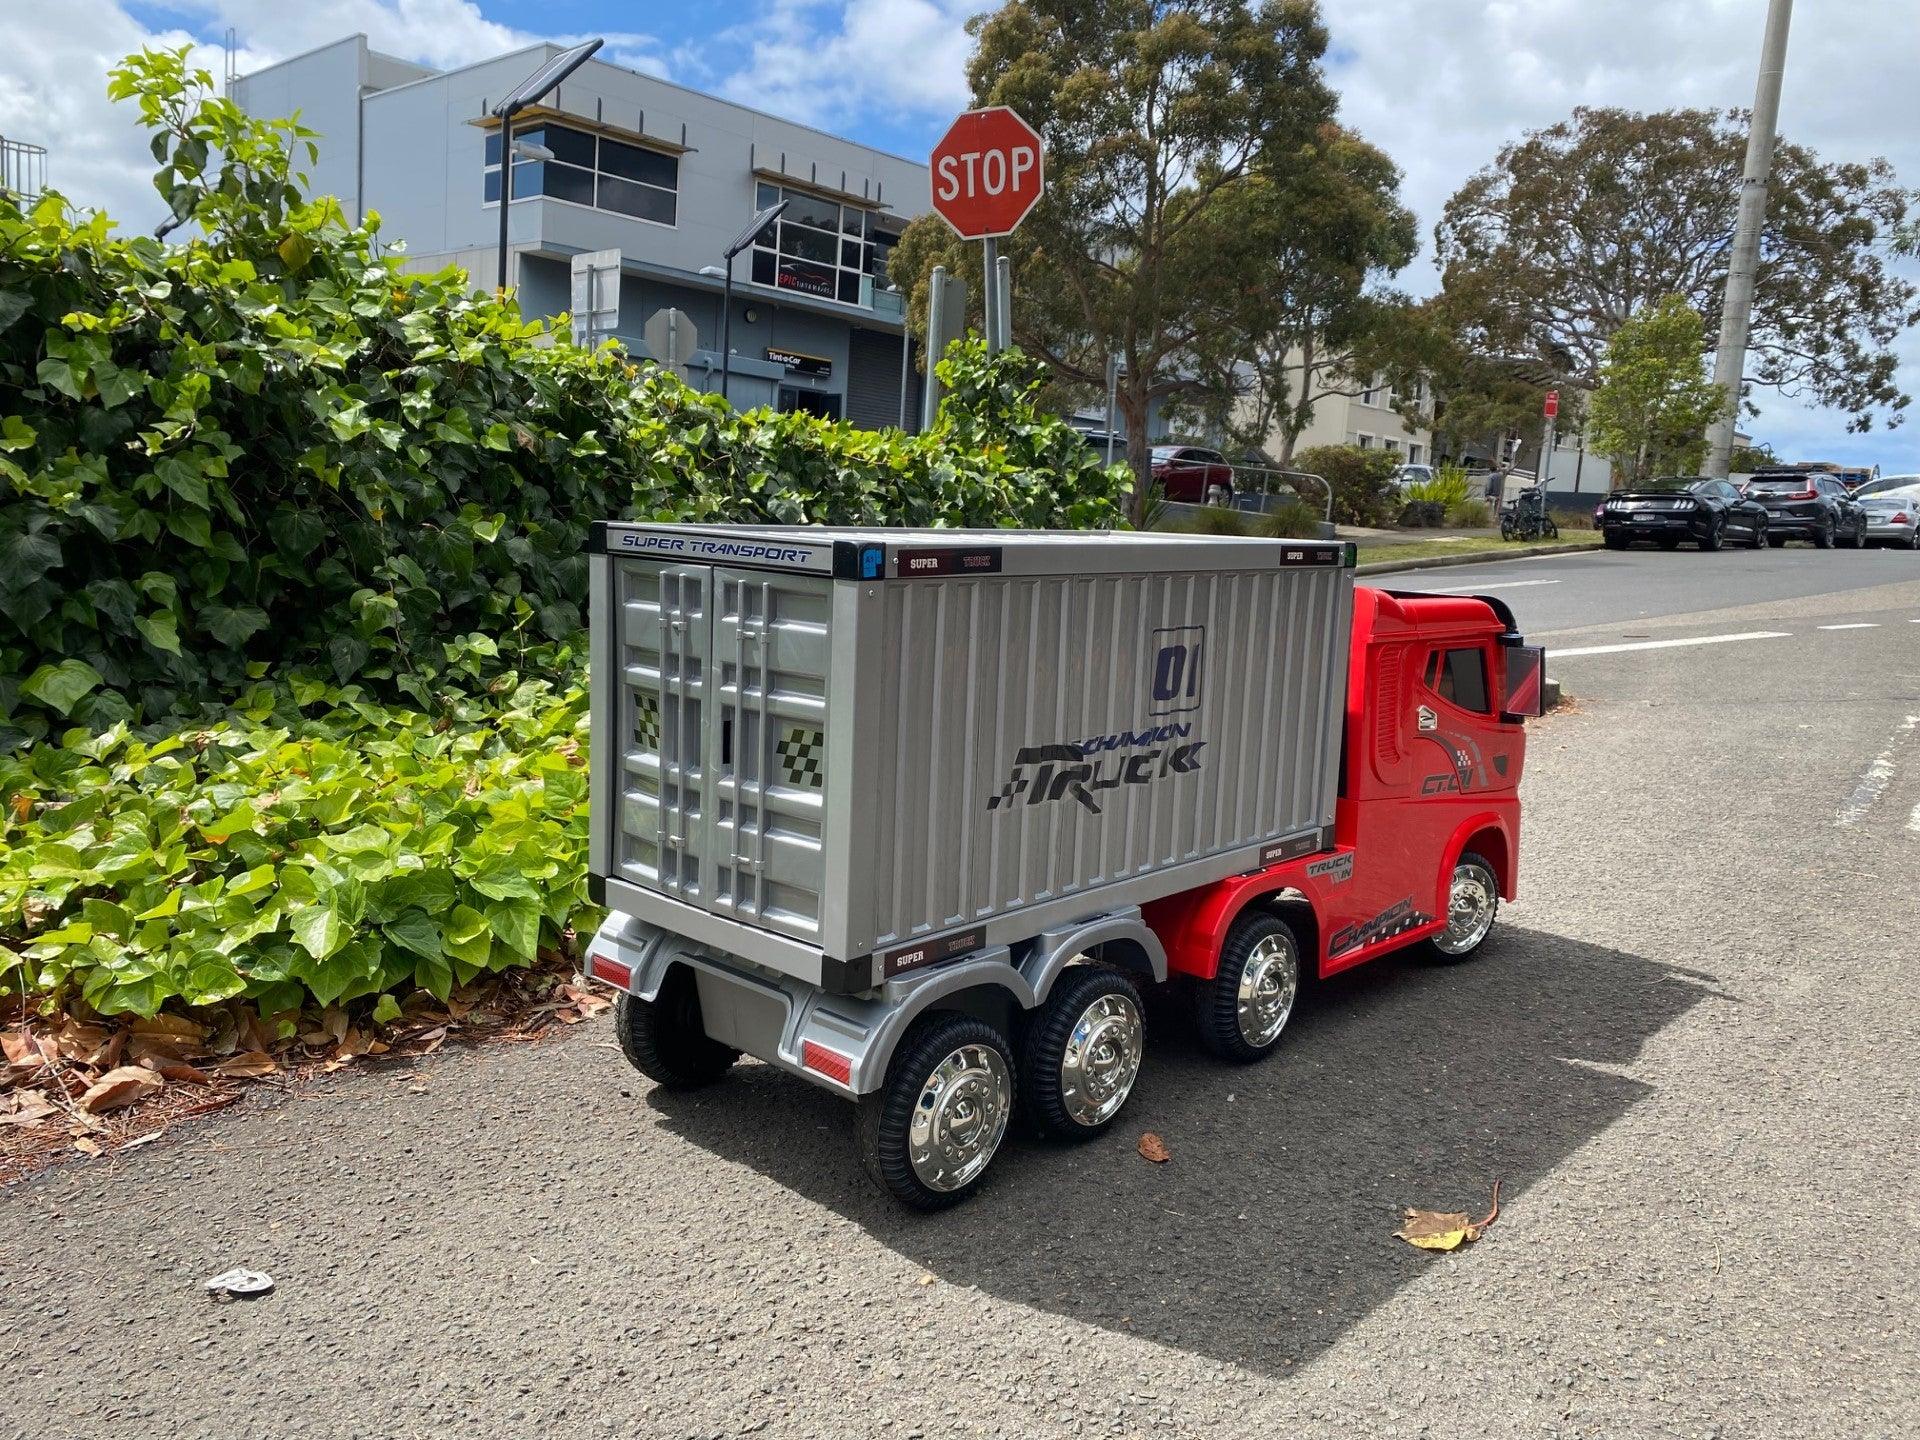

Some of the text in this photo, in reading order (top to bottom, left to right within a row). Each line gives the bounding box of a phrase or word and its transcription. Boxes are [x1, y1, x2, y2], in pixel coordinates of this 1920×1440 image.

[938, 146, 1034, 201] STOP
[778, 273, 797, 286] EPIC
[622, 535, 813, 563] SUPER TRANSPORT
[1287, 551, 1303, 560] SUPER
[910, 558, 938, 569] SUPER
[1152, 643, 1200, 701] 01
[1009, 741, 1208, 815] TRUCK
[1265, 848, 1282, 859] SUPER
[1309, 854, 1353, 875] TRUCK
[897, 950, 924, 967] SUPER
